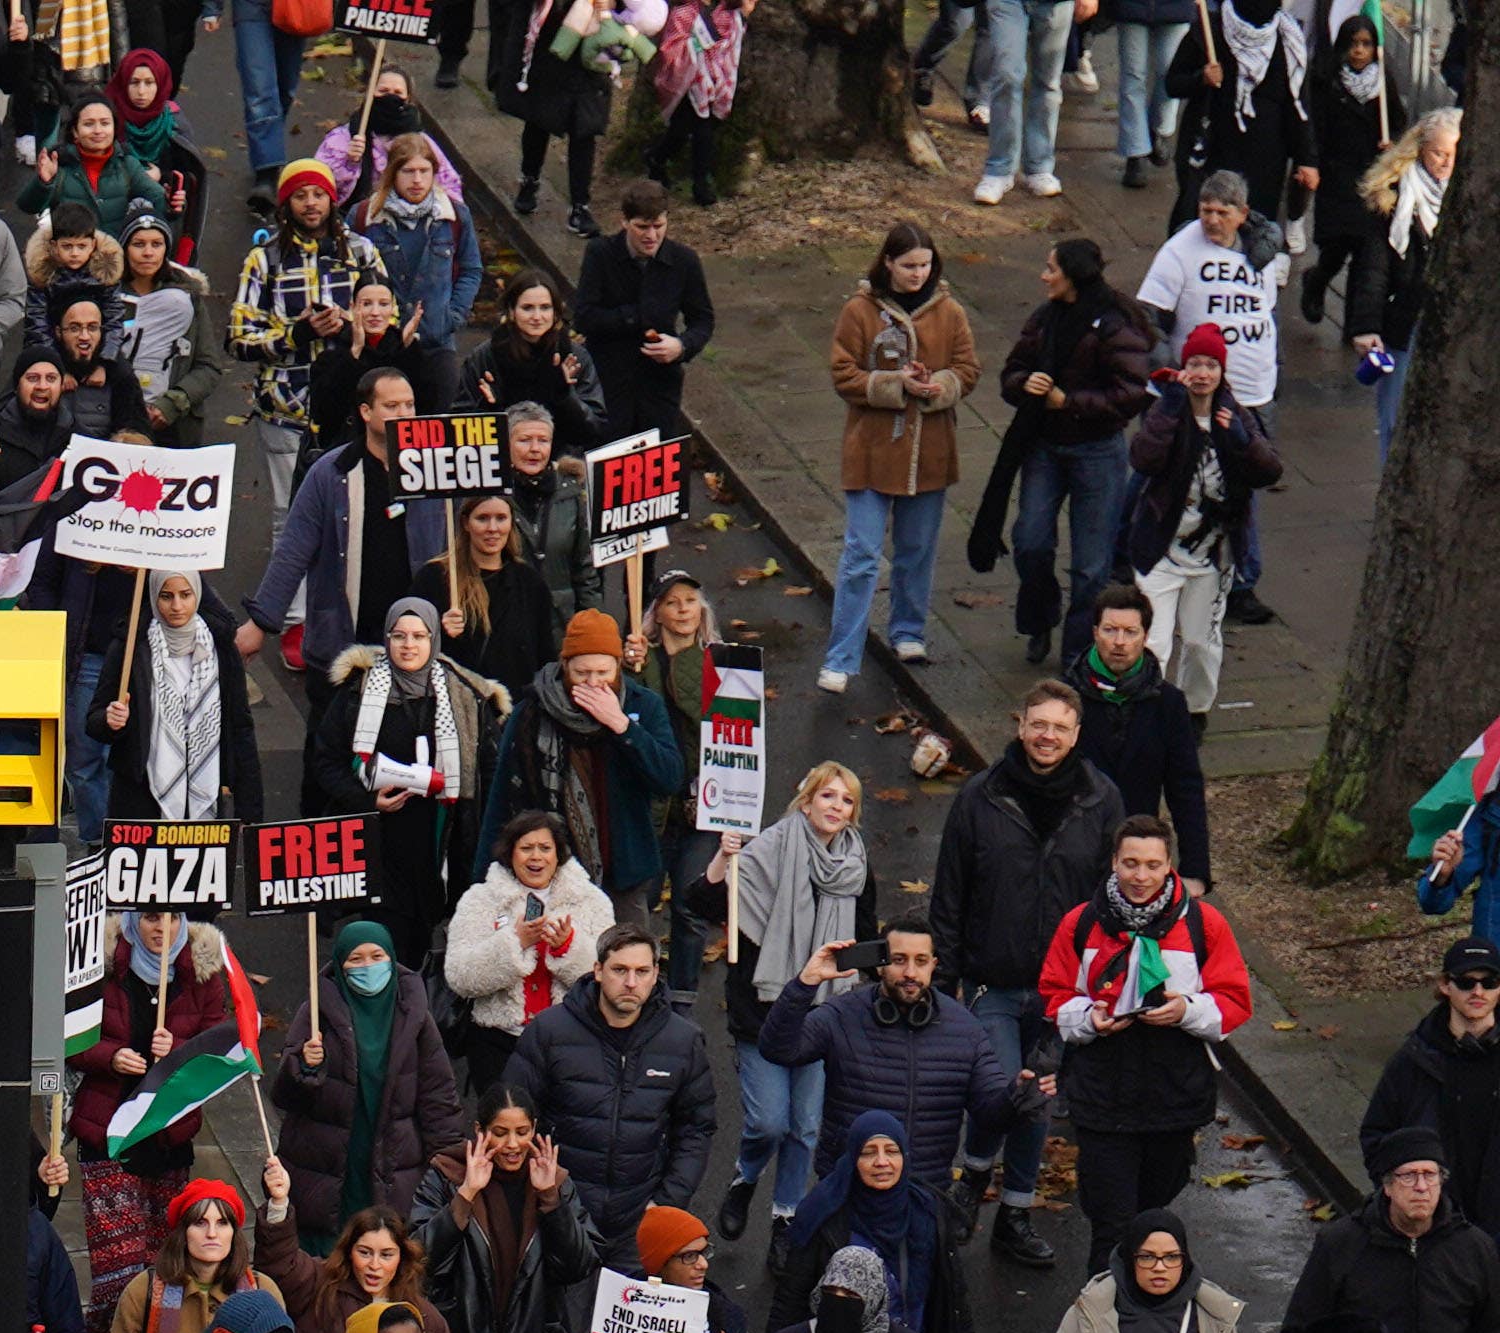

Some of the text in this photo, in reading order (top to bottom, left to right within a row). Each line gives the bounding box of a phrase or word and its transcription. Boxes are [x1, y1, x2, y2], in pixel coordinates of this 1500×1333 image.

[345, 7, 429, 36] PALESTINE
[1208, 295, 1260, 313] FIRE
[398, 417, 498, 448] END THE
[78, 458, 220, 512] Gza
[399, 445, 501, 491] SIEGE
[602, 443, 681, 509] FREE
[601, 492, 679, 533] PALESTINE
[112, 825, 230, 844] STOP BOMBING
[258, 819, 366, 880] FREE
[107, 847, 227, 903] GAZA
[260, 873, 366, 905] PALESTINE
[611, 1305, 686, 1333] END ISRAELI
